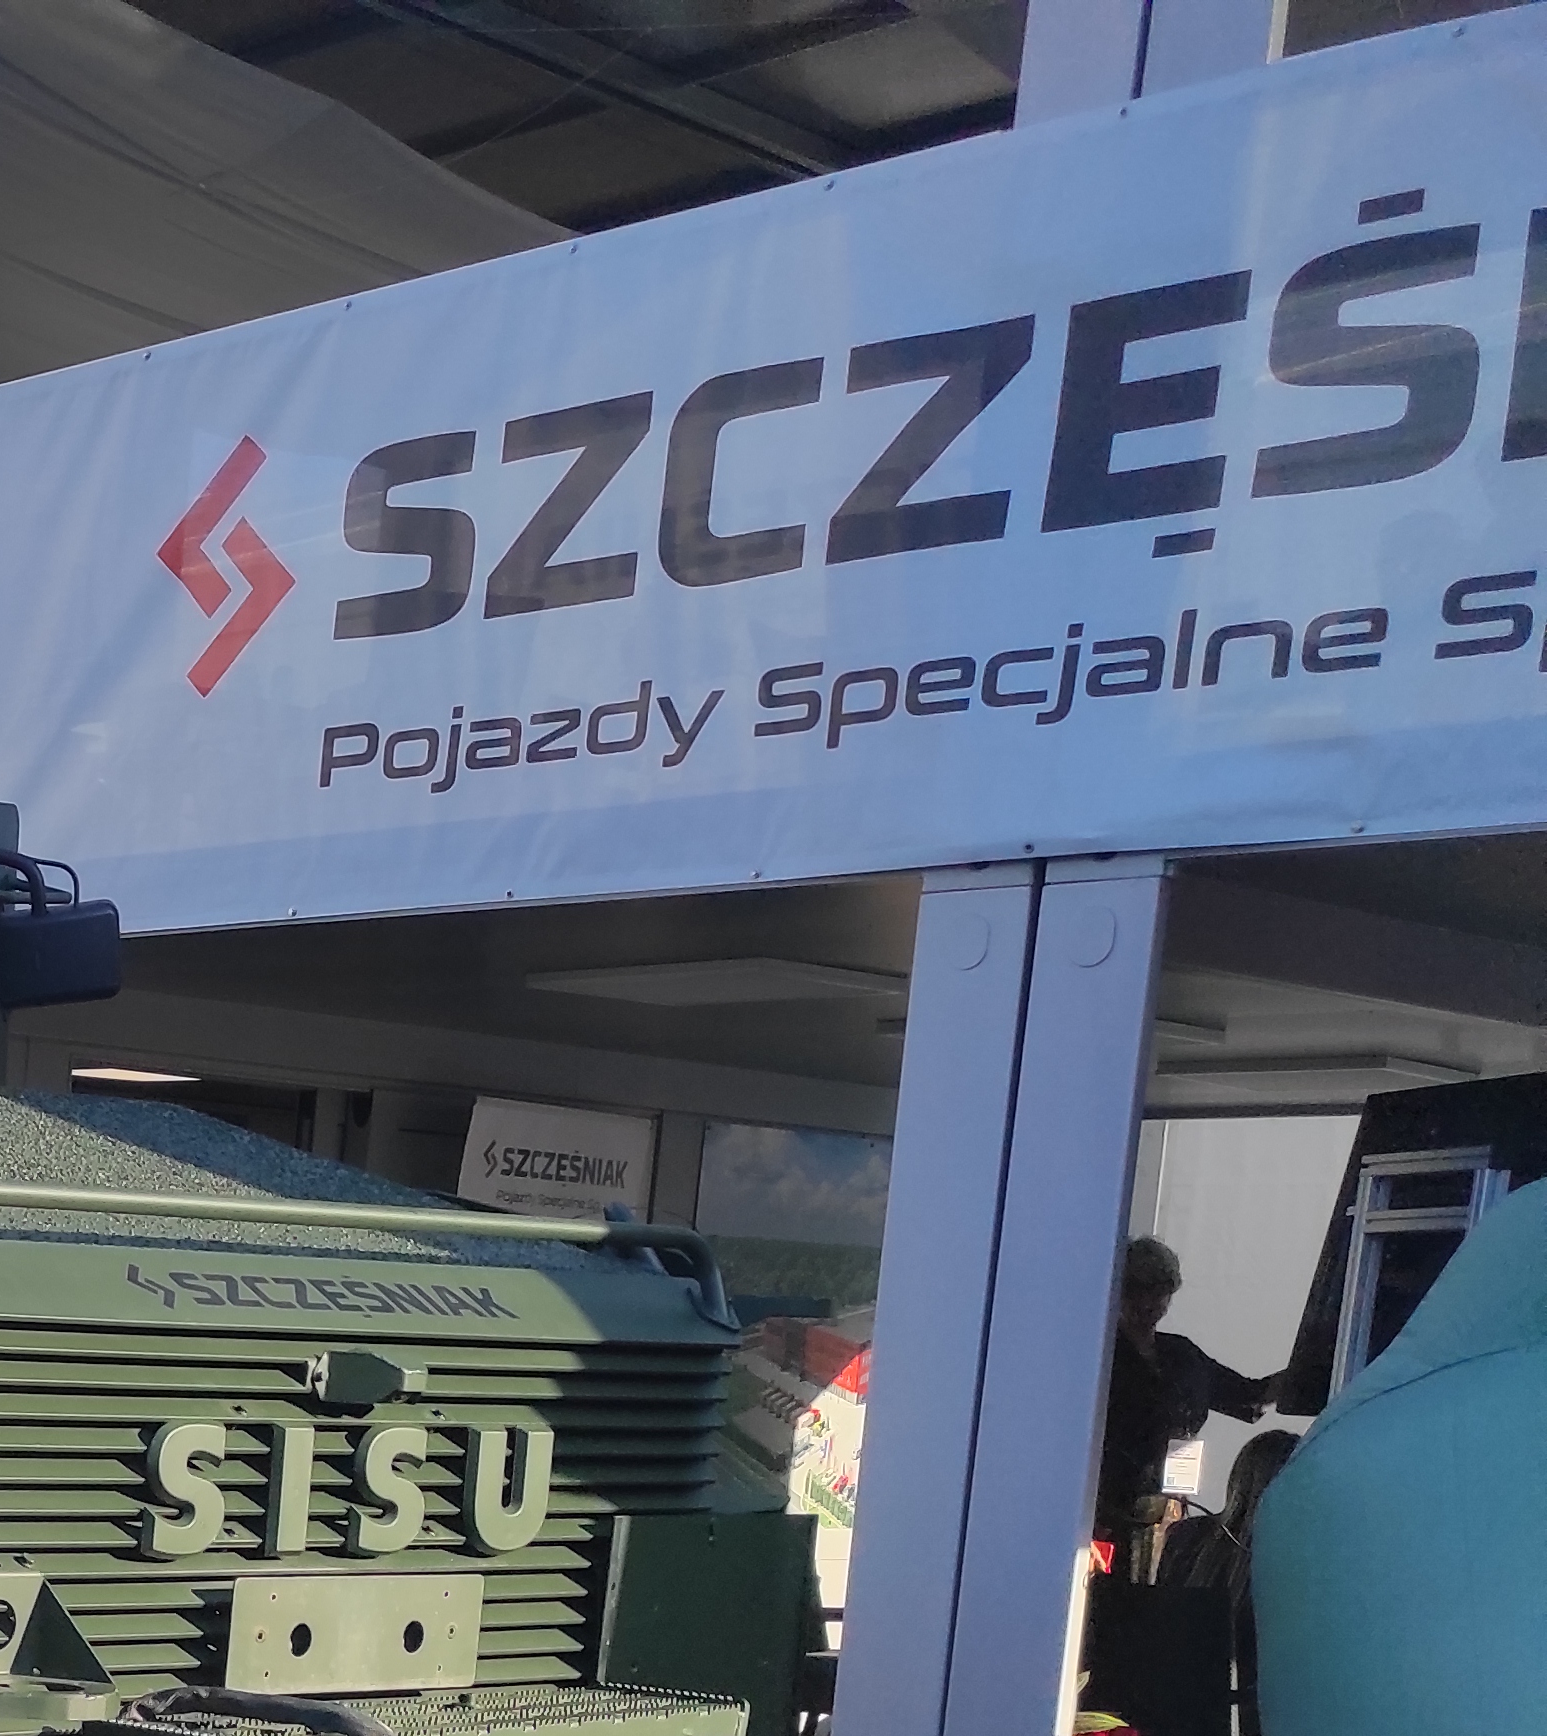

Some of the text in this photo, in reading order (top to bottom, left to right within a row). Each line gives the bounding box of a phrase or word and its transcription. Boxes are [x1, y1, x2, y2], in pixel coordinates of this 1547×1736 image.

[334, 188, 1547, 639] SZCZĘŚ
[318, 569, 1547, 793] Pojazdy Specjalne S
[500, 1147, 628, 1189] SZCZĘŚNIAK
[169, 1271, 520, 1321] SZCZĘŚNIAK
[139, 1419, 555, 1561] SISU
